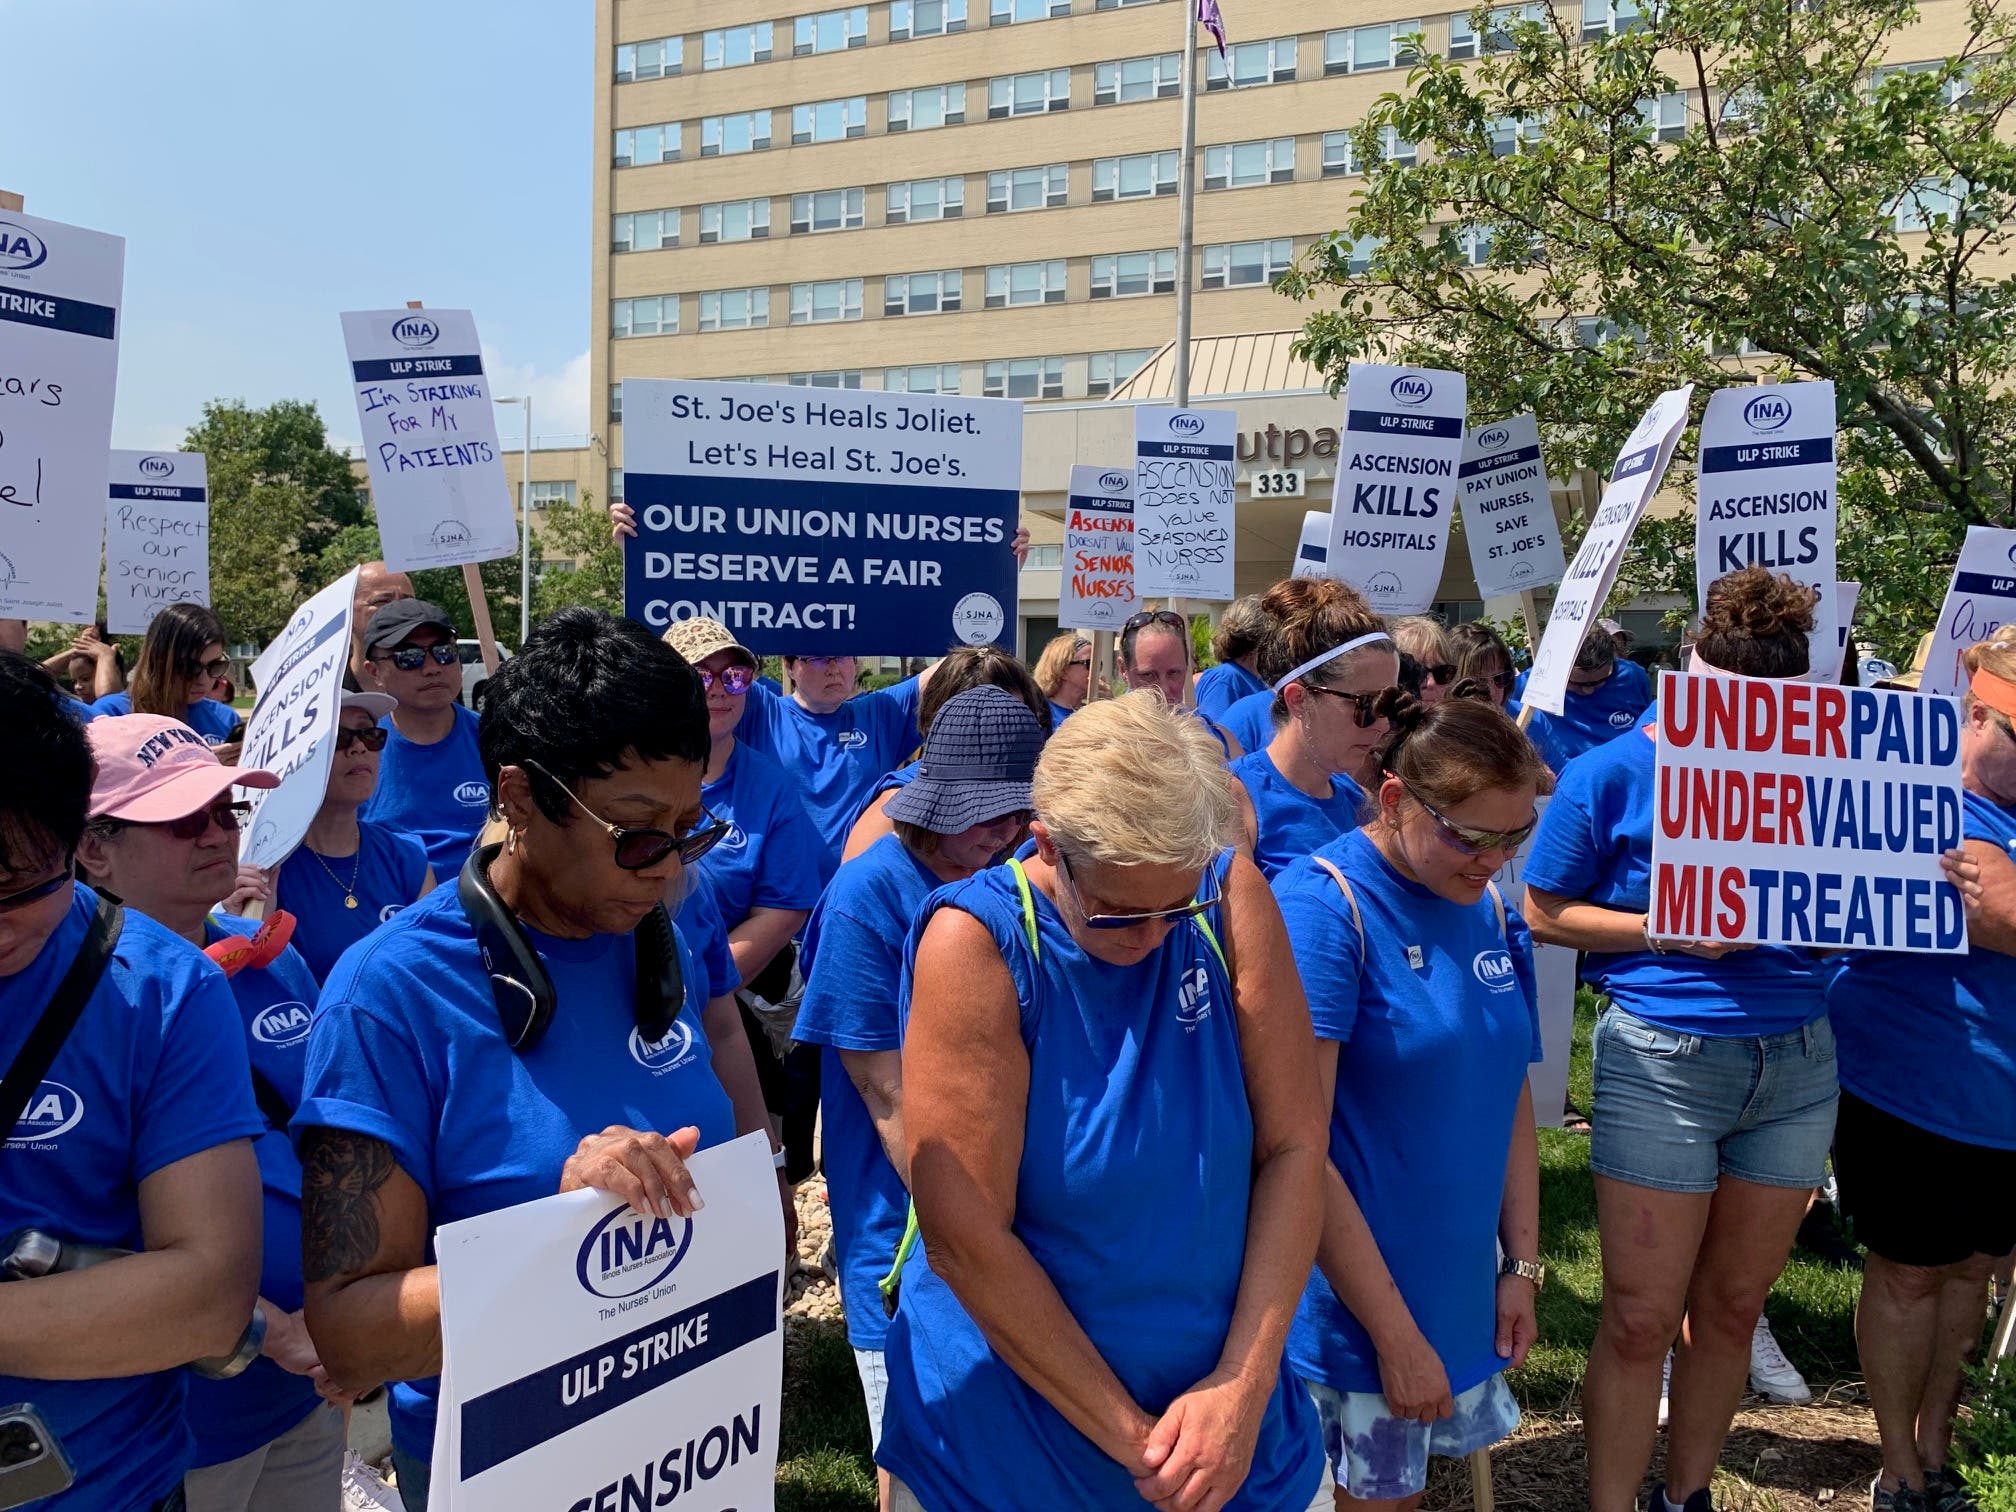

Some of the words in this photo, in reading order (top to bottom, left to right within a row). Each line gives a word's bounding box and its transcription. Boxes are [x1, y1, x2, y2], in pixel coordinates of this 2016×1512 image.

[0, 292, 56, 318] TRIKE
[401, 323, 433, 337] INA
[390, 361, 414, 373] ULP
[415, 359, 452, 373] STRIKE
[0, 378, 62, 406] ars
[1399, 381, 1426, 395] INA
[671, 395, 711, 420] St.
[719, 397, 796, 424] Joe's
[805, 402, 888, 429] Heals
[896, 407, 982, 436] Joliet.
[1753, 402, 1785, 419] INA
[1176, 419, 1199, 429] INA
[1380, 416, 1400, 427] ULP
[1401, 418, 1435, 430] STRIKE
[1236, 423, 1339, 467] utpa
[1483, 431, 1505, 444] INA
[688, 440, 758, 467] Let's
[767, 444, 835, 471] Heal
[845, 449, 882, 473] St.
[890, 451, 967, 478] Joe's.
[1163, 445, 1180, 453] ULP
[1181, 446, 1209, 455] STRIKE
[1478, 459, 1493, 469] ULP
[1494, 452, 1519, 466] STRIKE
[1737, 450, 1758, 462] ULP
[1762, 444, 1800, 460] STRIKE
[146, 461, 169, 471] INA
[1138, 460, 1235, 489] ASCENSION
[1350, 453, 1452, 477] ASCENSION
[1104, 475, 1124, 486] INA
[1258, 473, 1297, 494] 333
[1466, 477, 1492, 494] PAY
[1496, 465, 1538, 486] UNION
[135, 487, 151, 497] ULP
[152, 488, 182, 498] STRIKE
[1092, 499, 1107, 507] ULP
[1107, 500, 1131, 509] STRIKE
[1139, 492, 1200, 507] DOES
[1352, 483, 1440, 519] KILLS
[1480, 491, 1534, 514] NURSES,
[1709, 489, 1827, 521] ASCENSION
[118, 505, 208, 537] Respect
[643, 503, 726, 534] OUR
[736, 507, 856, 539] UNION
[865, 512, 1005, 544] NURSES
[1496, 515, 1528, 533] SAVE
[142, 541, 188, 558] our
[1343, 530, 1437, 551] HOSPITALS
[1488, 545, 1508, 559] ST.
[1511, 534, 1545, 554] JOE'S
[1719, 526, 1819, 573] KILLS
[645, 551, 818, 584] DESERVE
[826, 557, 855, 584] A
[863, 558, 942, 587] FAIR
[1568, 540, 1614, 580] KILLS
[1373, 584, 1395, 592] SJNA
[1991, 579, 2014, 591] ULP
[643, 599, 856, 631] CONTRACT!
[966, 610, 993, 619] SJNA
[1664, 674, 1958, 767] UNDERPAID
[137, 732, 173, 768] NEW
[462, 786, 488, 798] INA
[1660, 765, 1960, 855] UNDERVALUED
[1655, 862, 1964, 950] MISTREATED
[1480, 956, 1514, 977] INA
[262, 1008, 310, 1034] INA
[31, 1142, 58, 1151] Union
[601, 1216, 675, 1273] INA
[601, 1270, 621, 1281] Illinois
[622, 1261, 643, 1274] Nurses
[644, 1248, 677, 1265] Association
[598, 1306, 616, 1320] The
[618, 1291, 649, 1313] Nurses'
[653, 1283, 677, 1300] Union
[561, 1355, 615, 1407] ULP
[621, 1313, 709, 1378] STRIKE
[567, 1404, 760, 1512] ENSION
